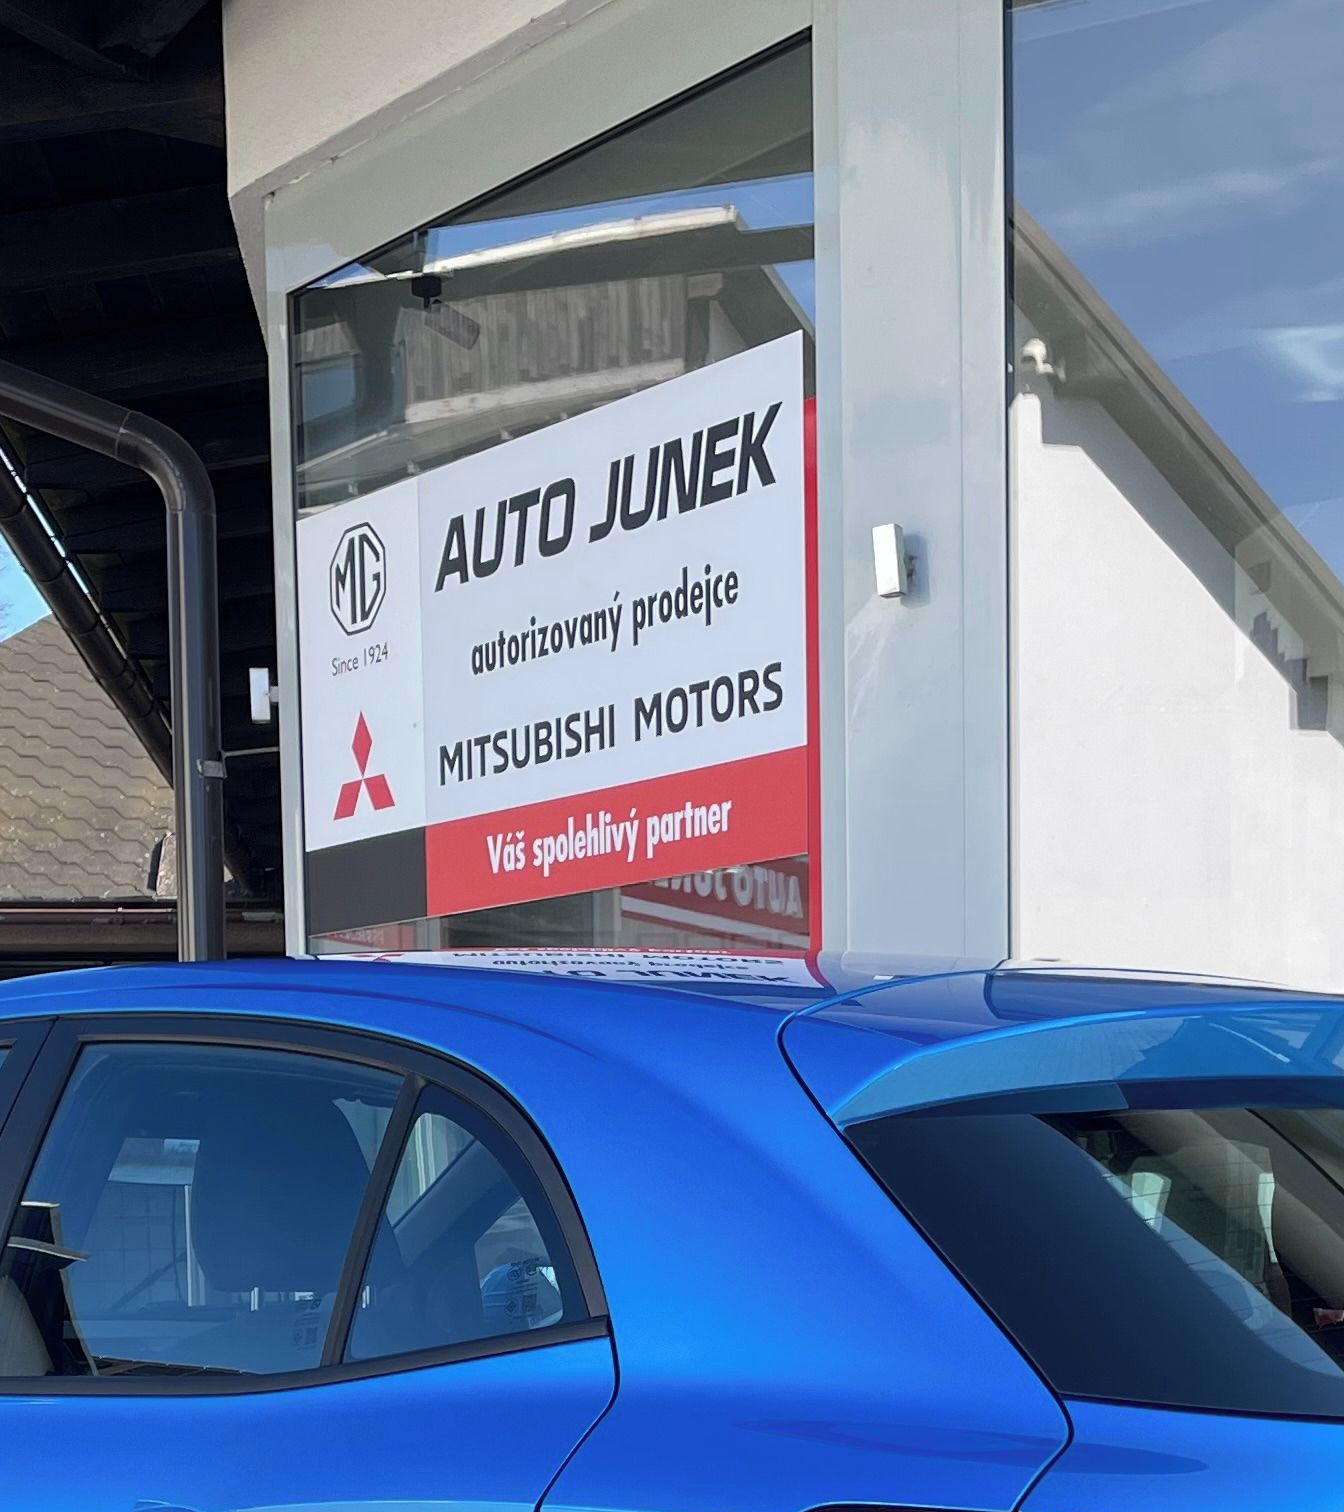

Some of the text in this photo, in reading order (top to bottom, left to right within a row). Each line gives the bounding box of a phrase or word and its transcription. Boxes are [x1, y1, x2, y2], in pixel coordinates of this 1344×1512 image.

[434, 401, 783, 593] AUTO JUNEK
[334, 531, 381, 626] MG
[471, 563, 739, 676] autorizovaný prodejce
[331, 642, 389, 677] Since 1924
[439, 661, 783, 786] MITSUBISHI MOTORS
[486, 800, 732, 878] Váš spolehlivý partner
